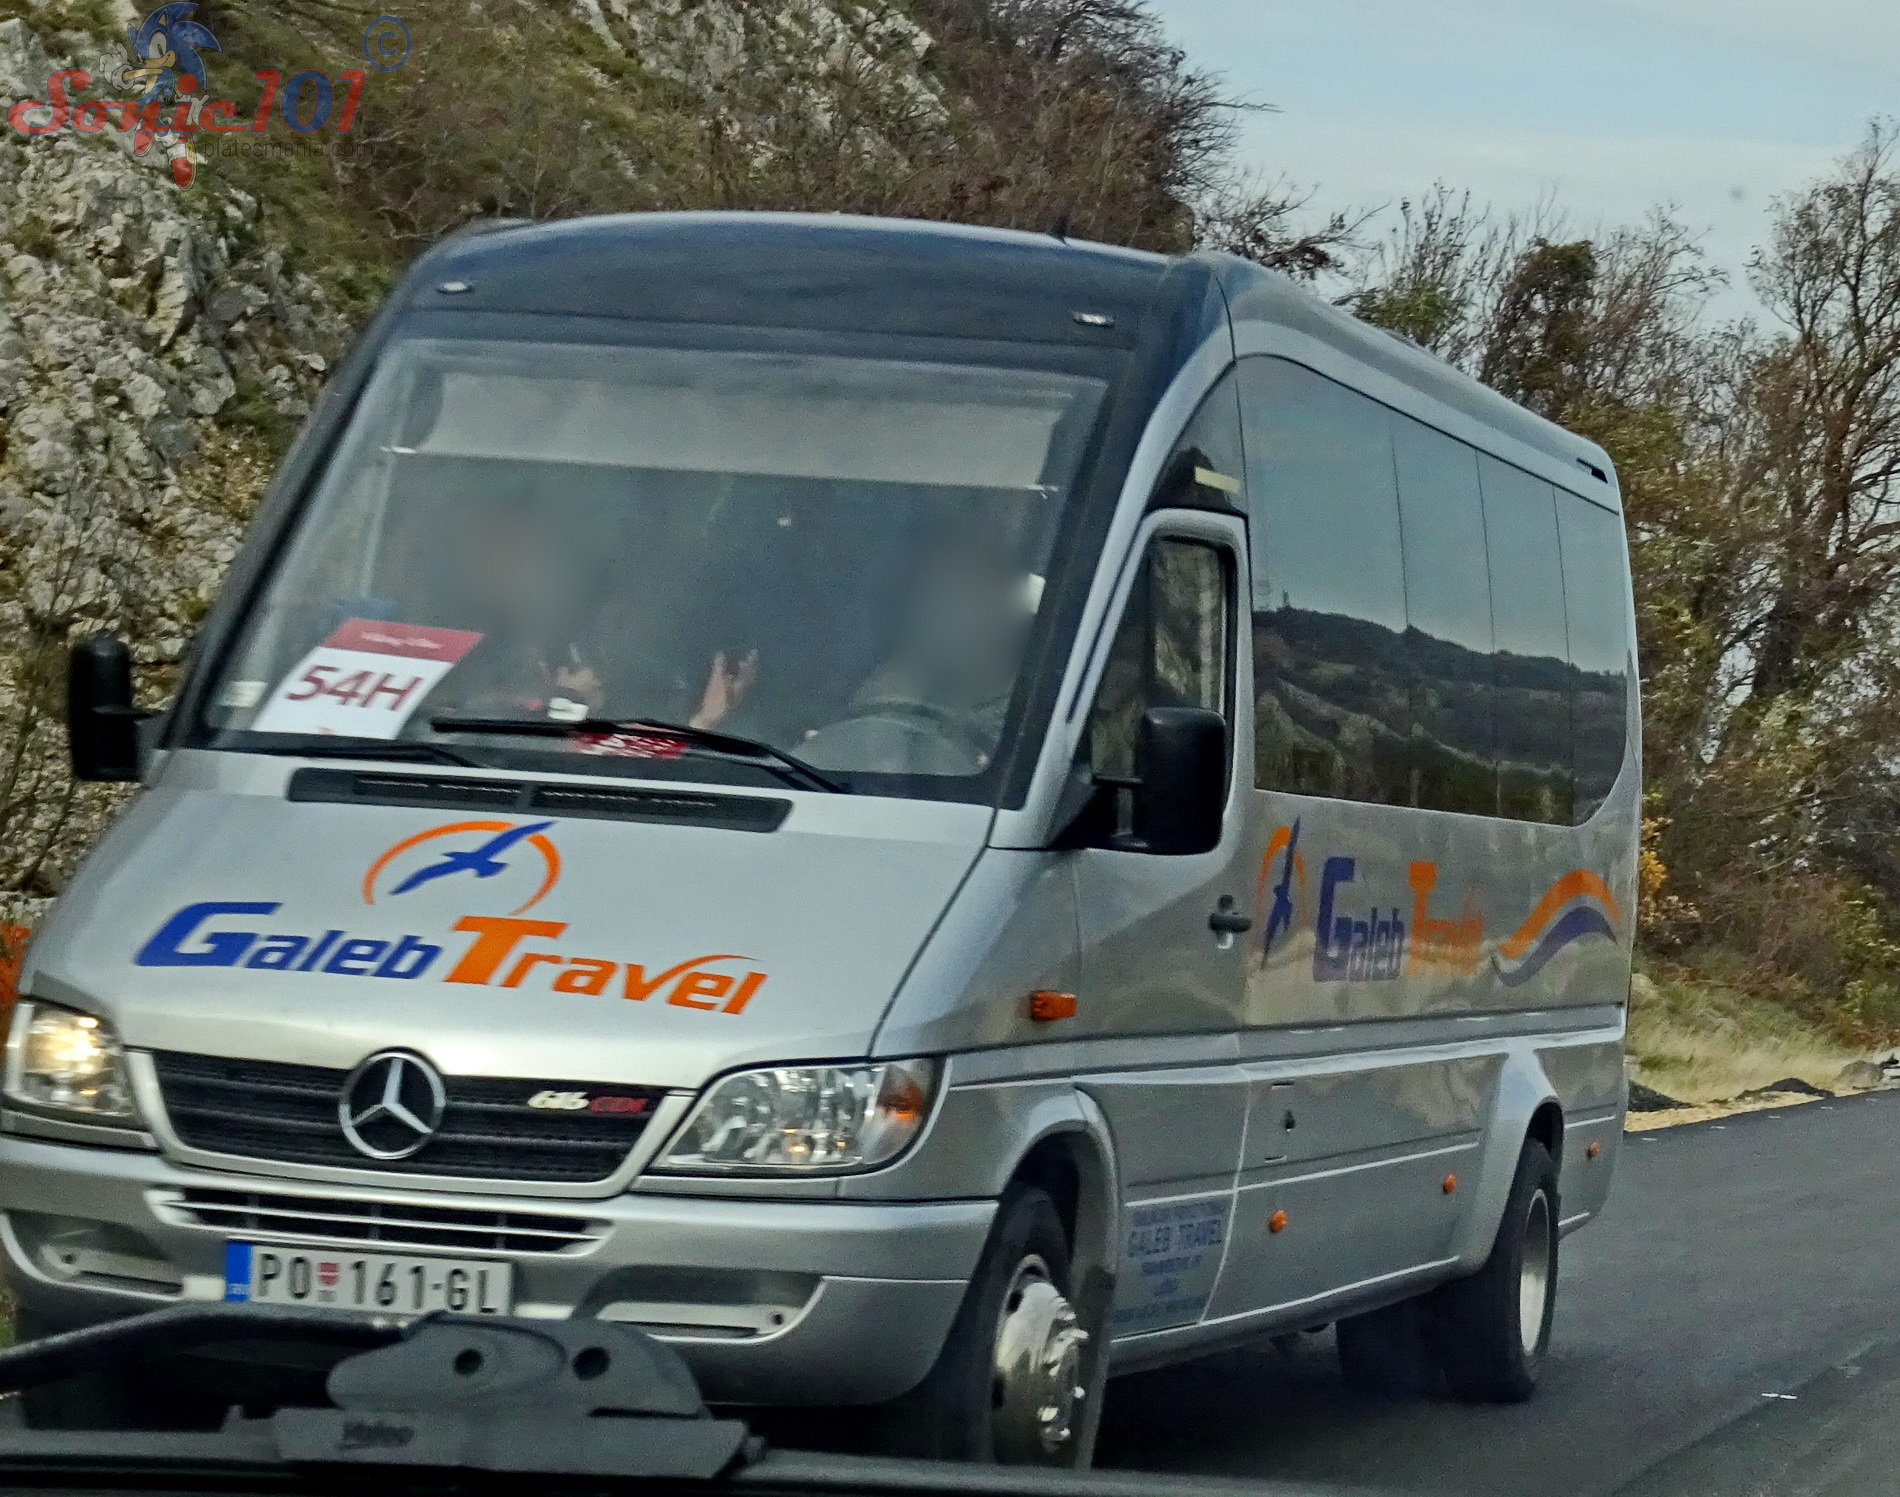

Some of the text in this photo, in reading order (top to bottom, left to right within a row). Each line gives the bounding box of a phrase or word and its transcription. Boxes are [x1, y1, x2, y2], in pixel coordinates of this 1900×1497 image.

[287, 664, 423, 712] 54H
[134, 901, 769, 1016] Galeb Travel
[349, 1260, 498, 1314] 161-GL
